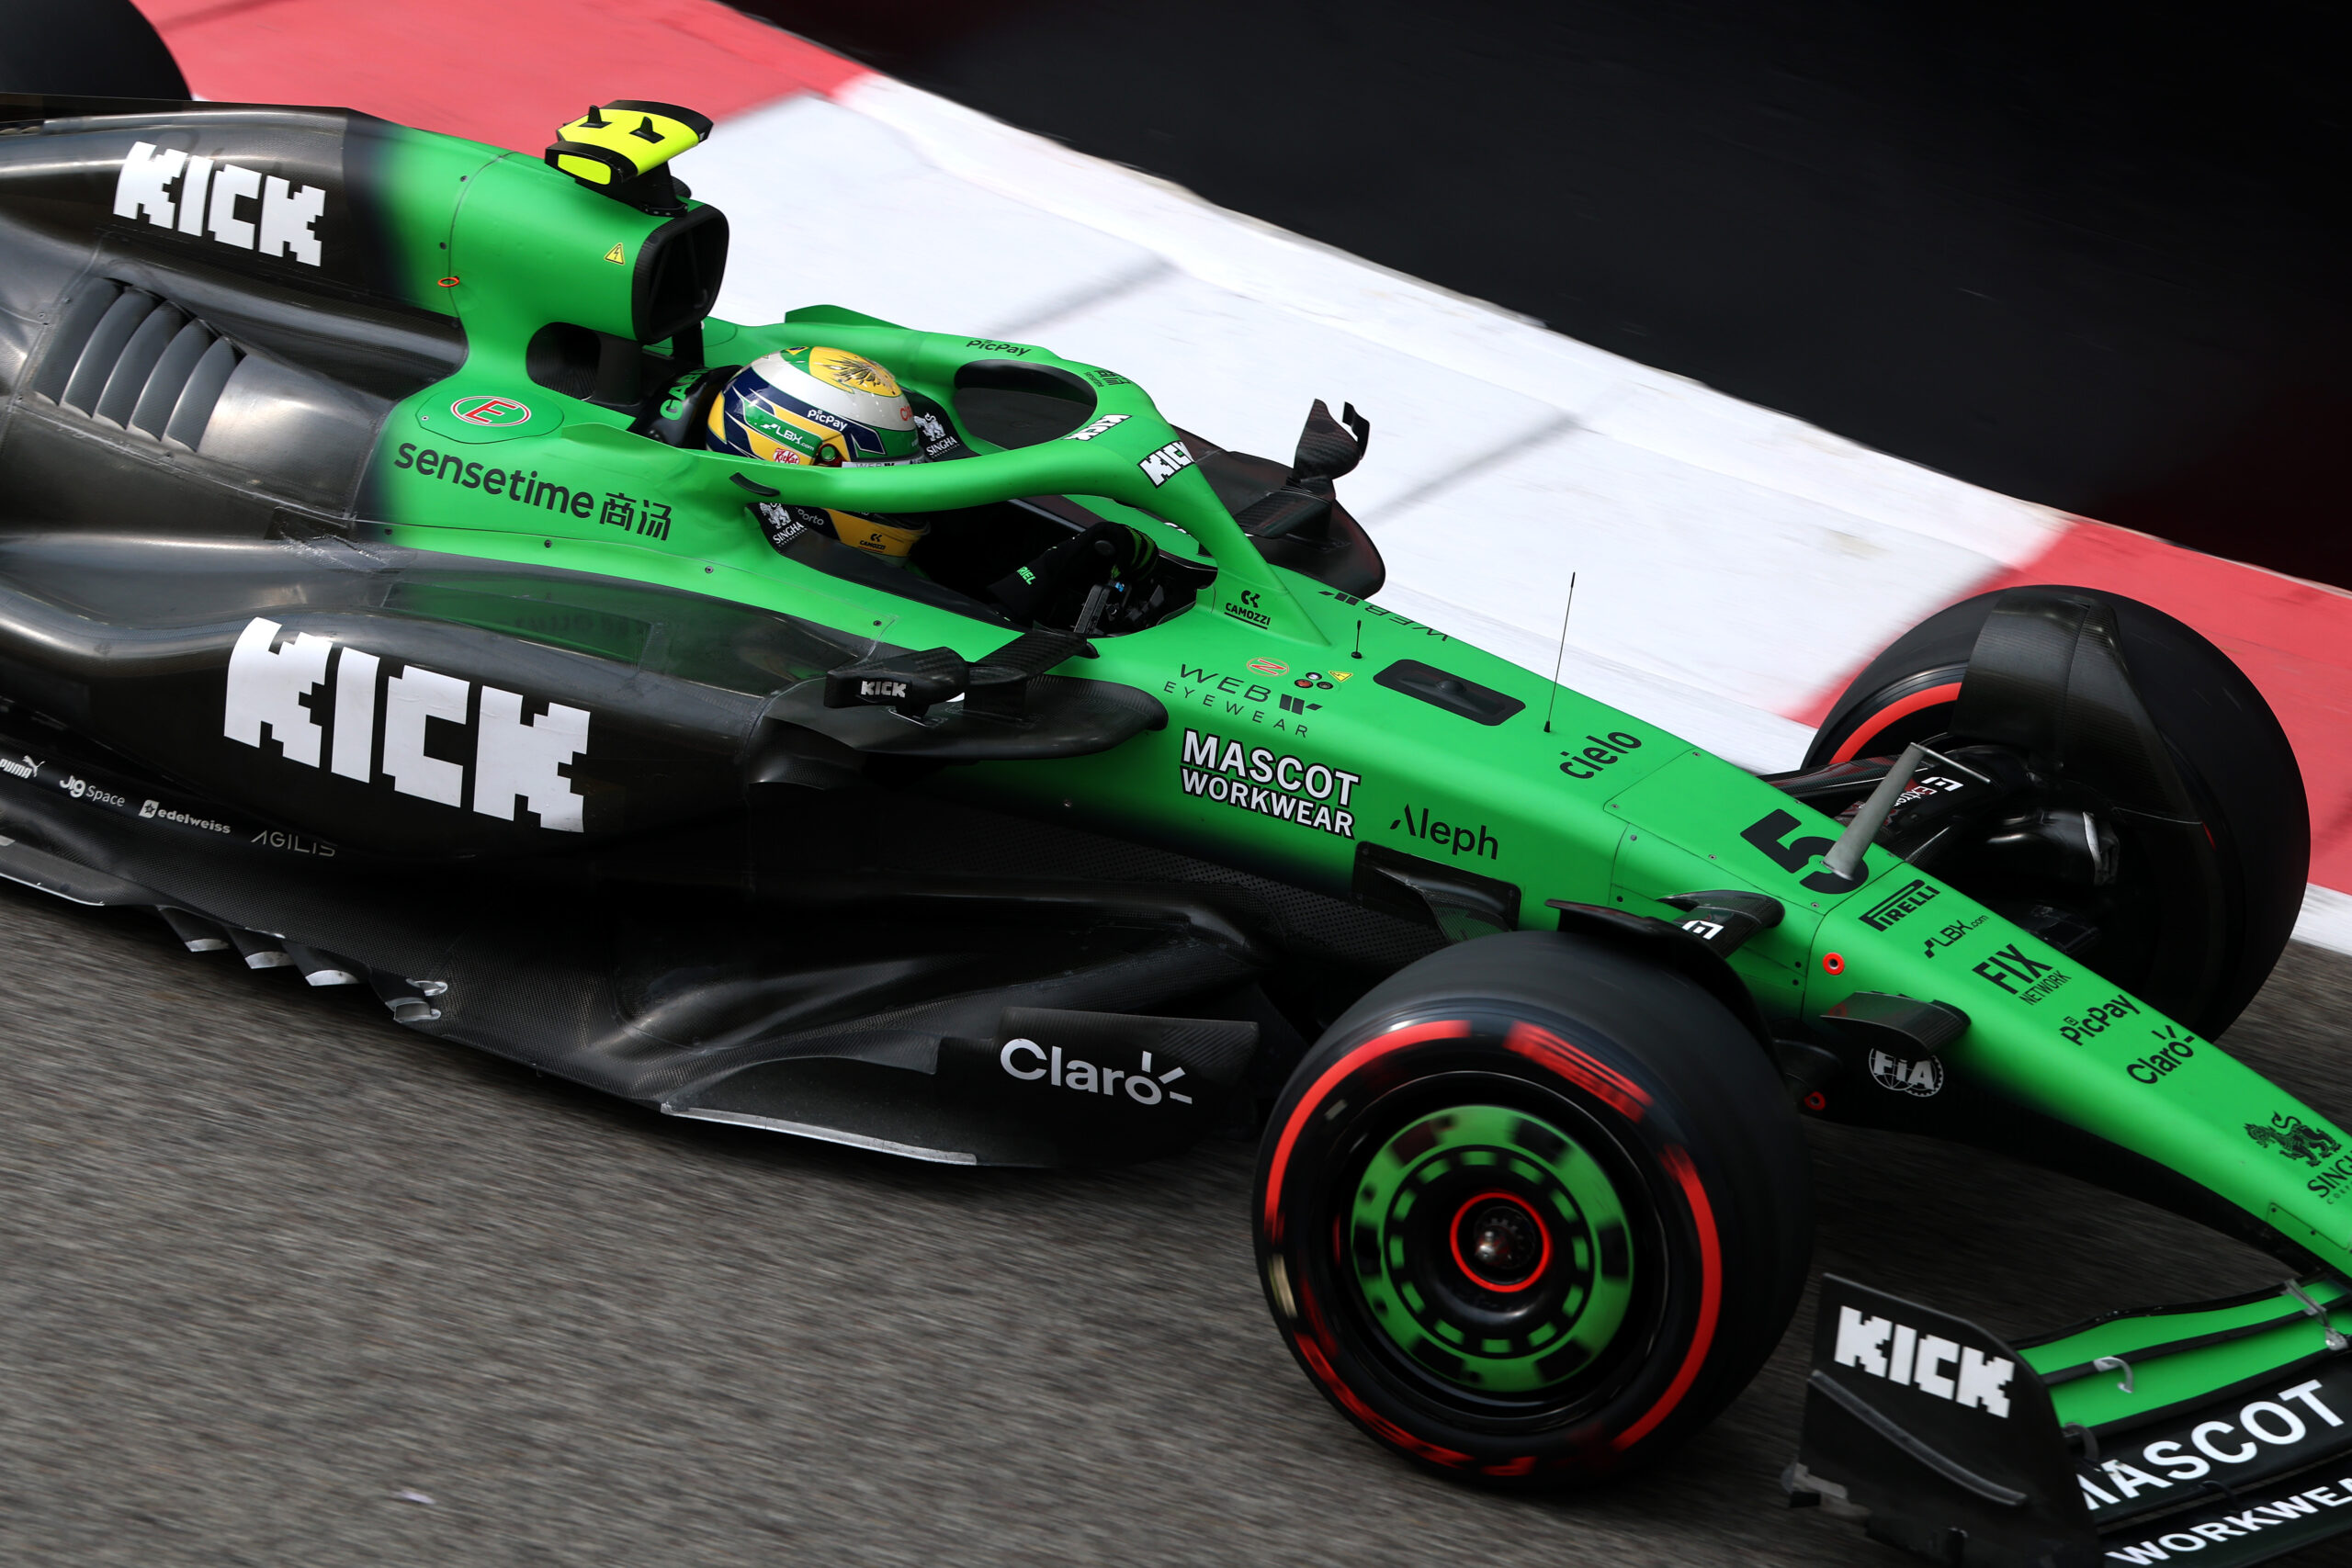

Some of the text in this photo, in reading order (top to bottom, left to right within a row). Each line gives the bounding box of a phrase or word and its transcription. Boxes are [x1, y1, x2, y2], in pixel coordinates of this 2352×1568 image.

[114, 141, 325, 266] KICK
[966, 339, 1032, 356] PicPay
[808, 410, 848, 431] PicPay
[1062, 413, 1132, 441] KICK
[925, 436, 957, 456] SINGHA
[394, 442, 673, 540] sensetime 商汤
[773, 522, 805, 544] SINGHA
[1225, 602, 1271, 626] CAMOZZI
[861, 681, 907, 698] KICK
[1181, 664, 1272, 702] WEB
[223, 616, 590, 833] KICK
[1163, 681, 1307, 738] EYEWEAR
[1182, 729, 1361, 806] MASCOT
[1560, 732, 1642, 779] cielo
[158, 807, 231, 834] edelweiss
[1181, 767, 1354, 839] WORKWEAR
[251, 829, 337, 857] AGILIS
[1390, 804, 1498, 860] Aleph
[1740, 808, 1869, 895] 5
[1860, 879, 1940, 931] PIRELLI
[1972, 943, 2053, 995] FIX
[2018, 970, 2072, 1006] NETWORK
[2059, 994, 2141, 1046] PicPay
[1001, 1038, 1161, 1105] Claro
[2126, 1036, 2194, 1085] Claro
[2307, 1155, 2352, 1198] SING
[1835, 1306, 2015, 1419] KICK
